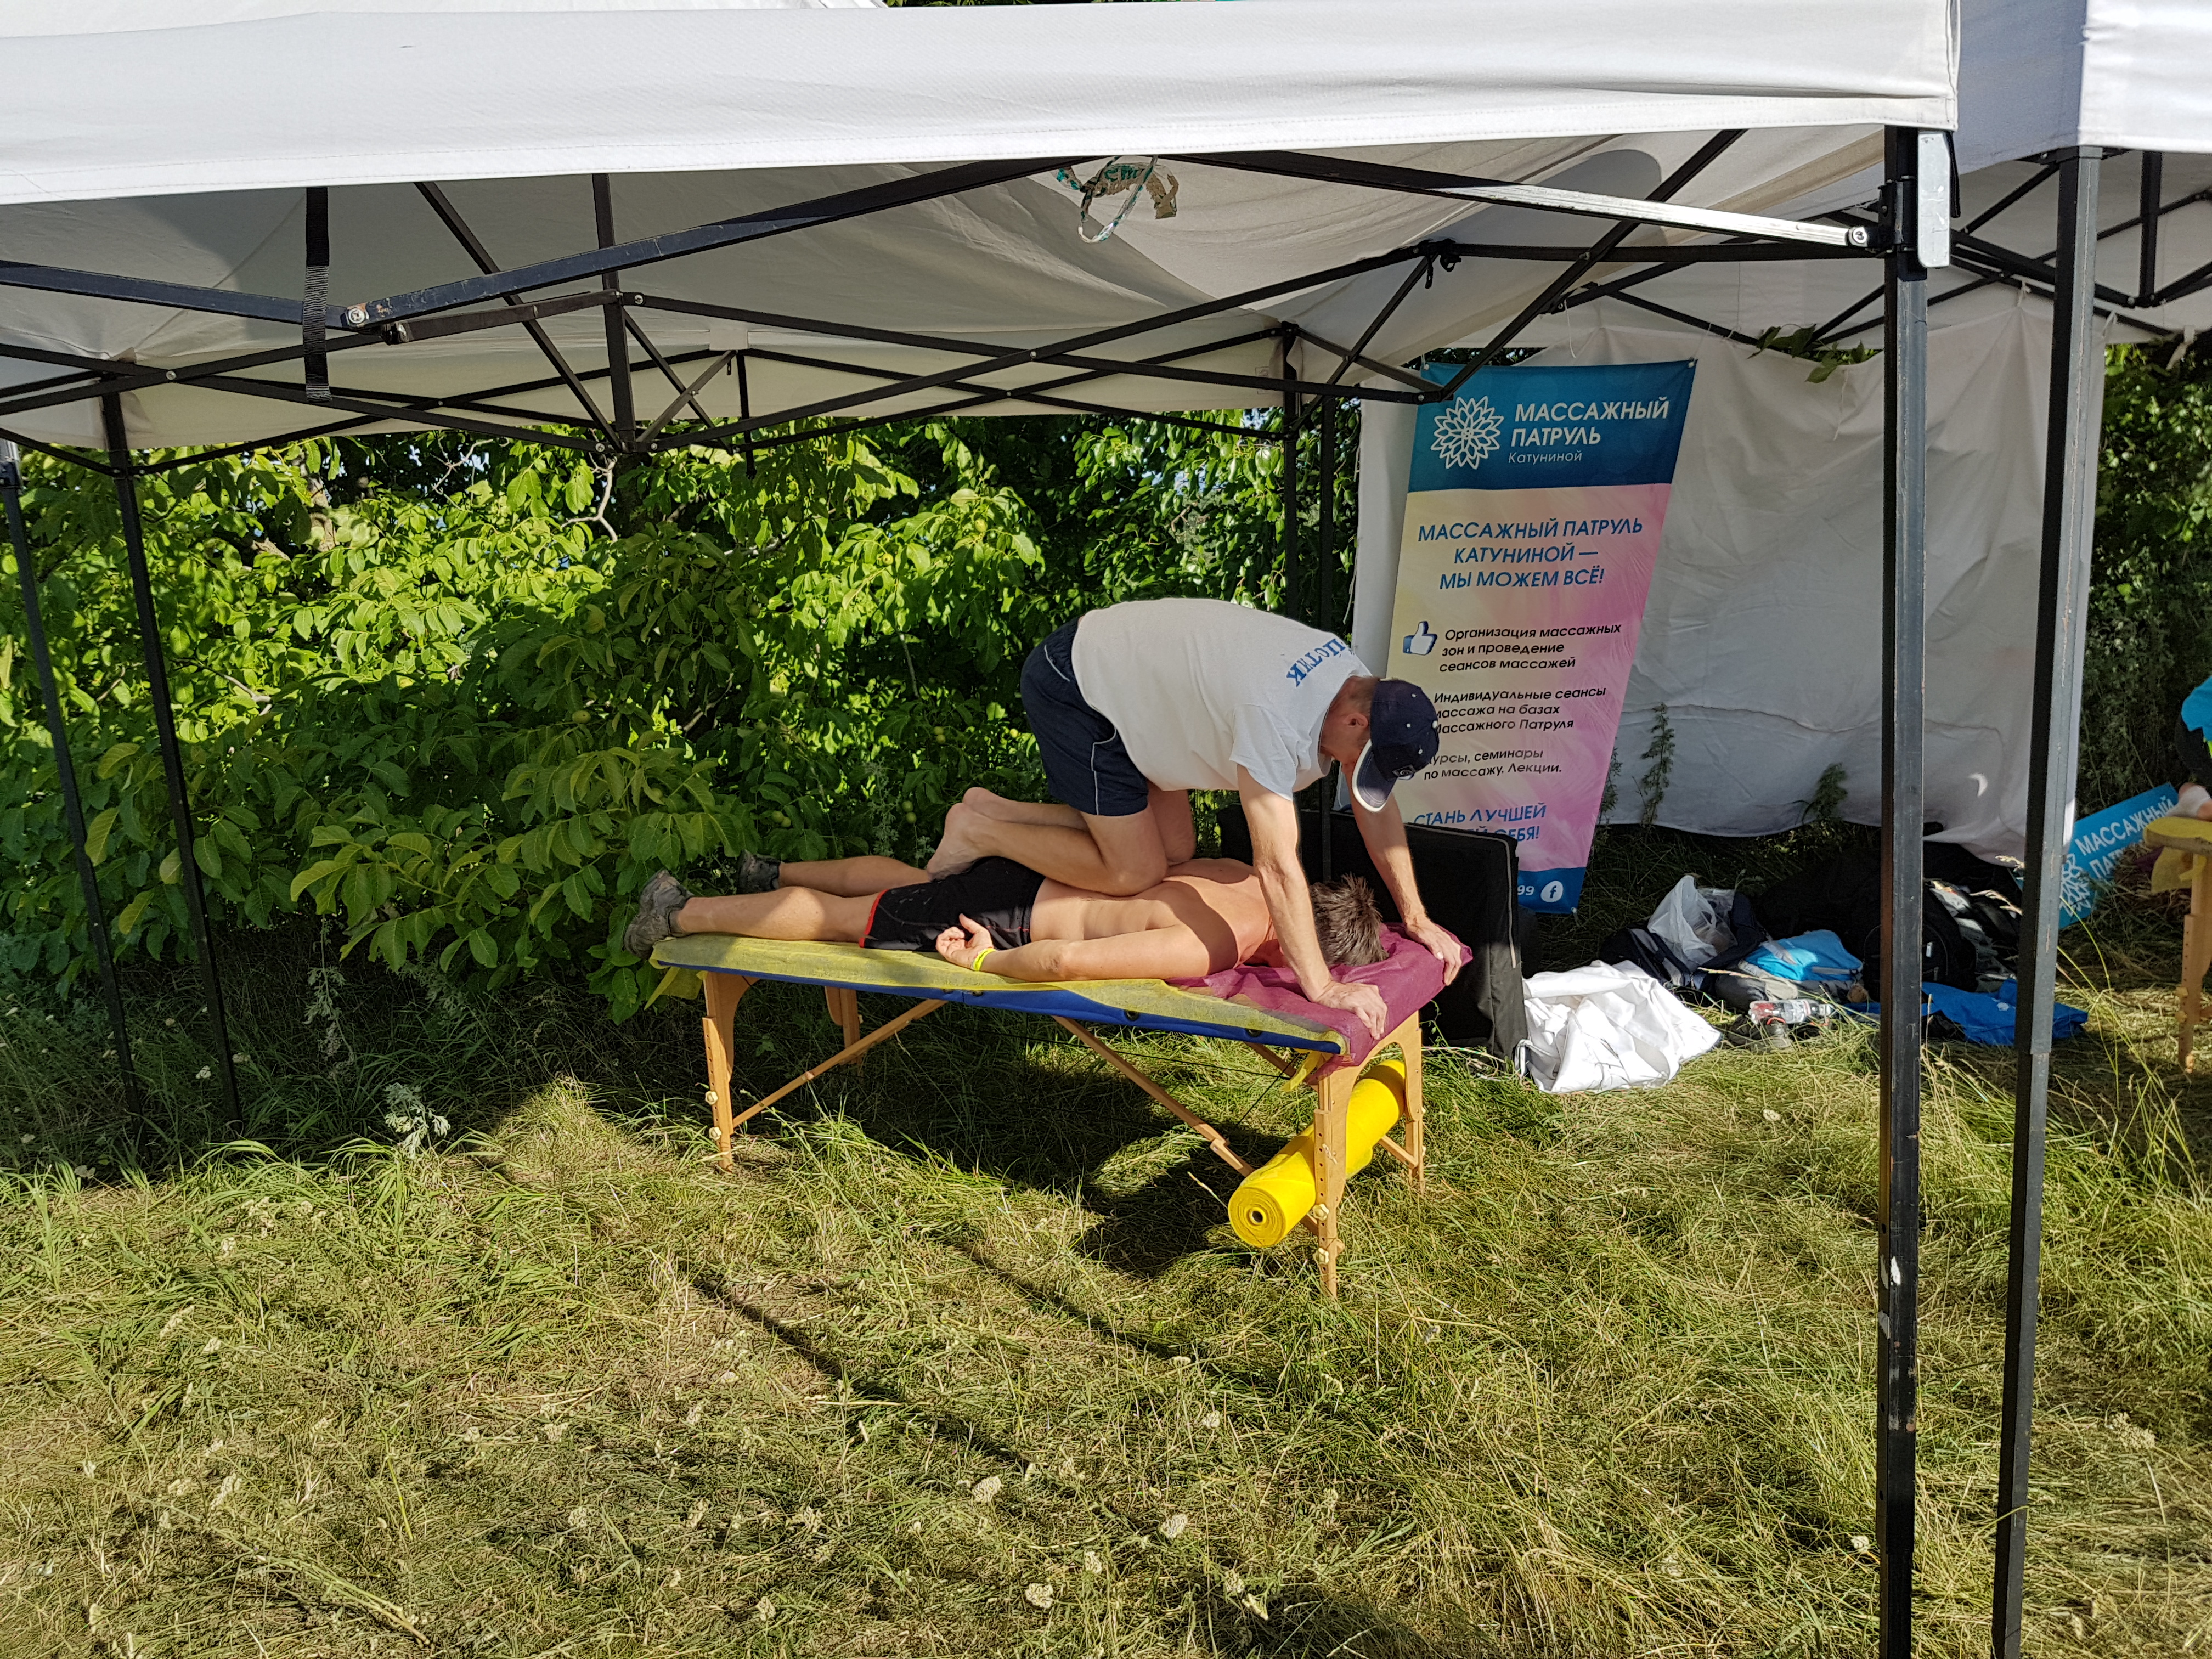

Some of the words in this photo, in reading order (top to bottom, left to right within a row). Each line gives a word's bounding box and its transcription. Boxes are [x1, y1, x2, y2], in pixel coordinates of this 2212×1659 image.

[1515, 396, 1669, 422] МАССАЖНЫЙ
[1511, 426, 1601, 447] ПАТРУЛЬ
[1509, 450, 1583, 465] Катуниной
[1418, 517, 1559, 541] МАССАЖНЫЙ
[1562, 517, 1643, 537] ПАТРУЛЬ
[1454, 542, 1575, 564] КАТУНИНОЙ
[1440, 572, 1472, 590] МЫ
[1476, 570, 1559, 588] МОЖЕМ
[1564, 565, 1605, 585] ВСЁ!
[1445, 629, 1536, 642] Организация
[1539, 624, 1622, 637] массажных
[1442, 647, 1464, 657] зон
[1467, 646, 1475, 654] и
[1478, 644, 1565, 655] проведение
[1440, 660, 1496, 672] сеансов
[1499, 656, 1576, 669] массажей
[1434, 691, 1552, 704] Индивидуальные
[1555, 687, 1606, 699] сеансы
[1498, 706, 1516, 714] на
[1519, 704, 1560, 714] базах
[1519, 719, 1574, 731] Патруля
[1430, 754, 1470, 766] урсы,
[1474, 750, 1544, 762] семинары
[1424, 770, 1438, 780] по
[1441, 765, 1504, 777] массажу.
[1508, 763, 1562, 774] Лекции.
[1414, 809, 1466, 825] СТАНЬ
[1470, 802, 1547, 823] ЛУЧШЕЙ
[2075, 795, 2176, 856] МАССАЖНЫЙ
